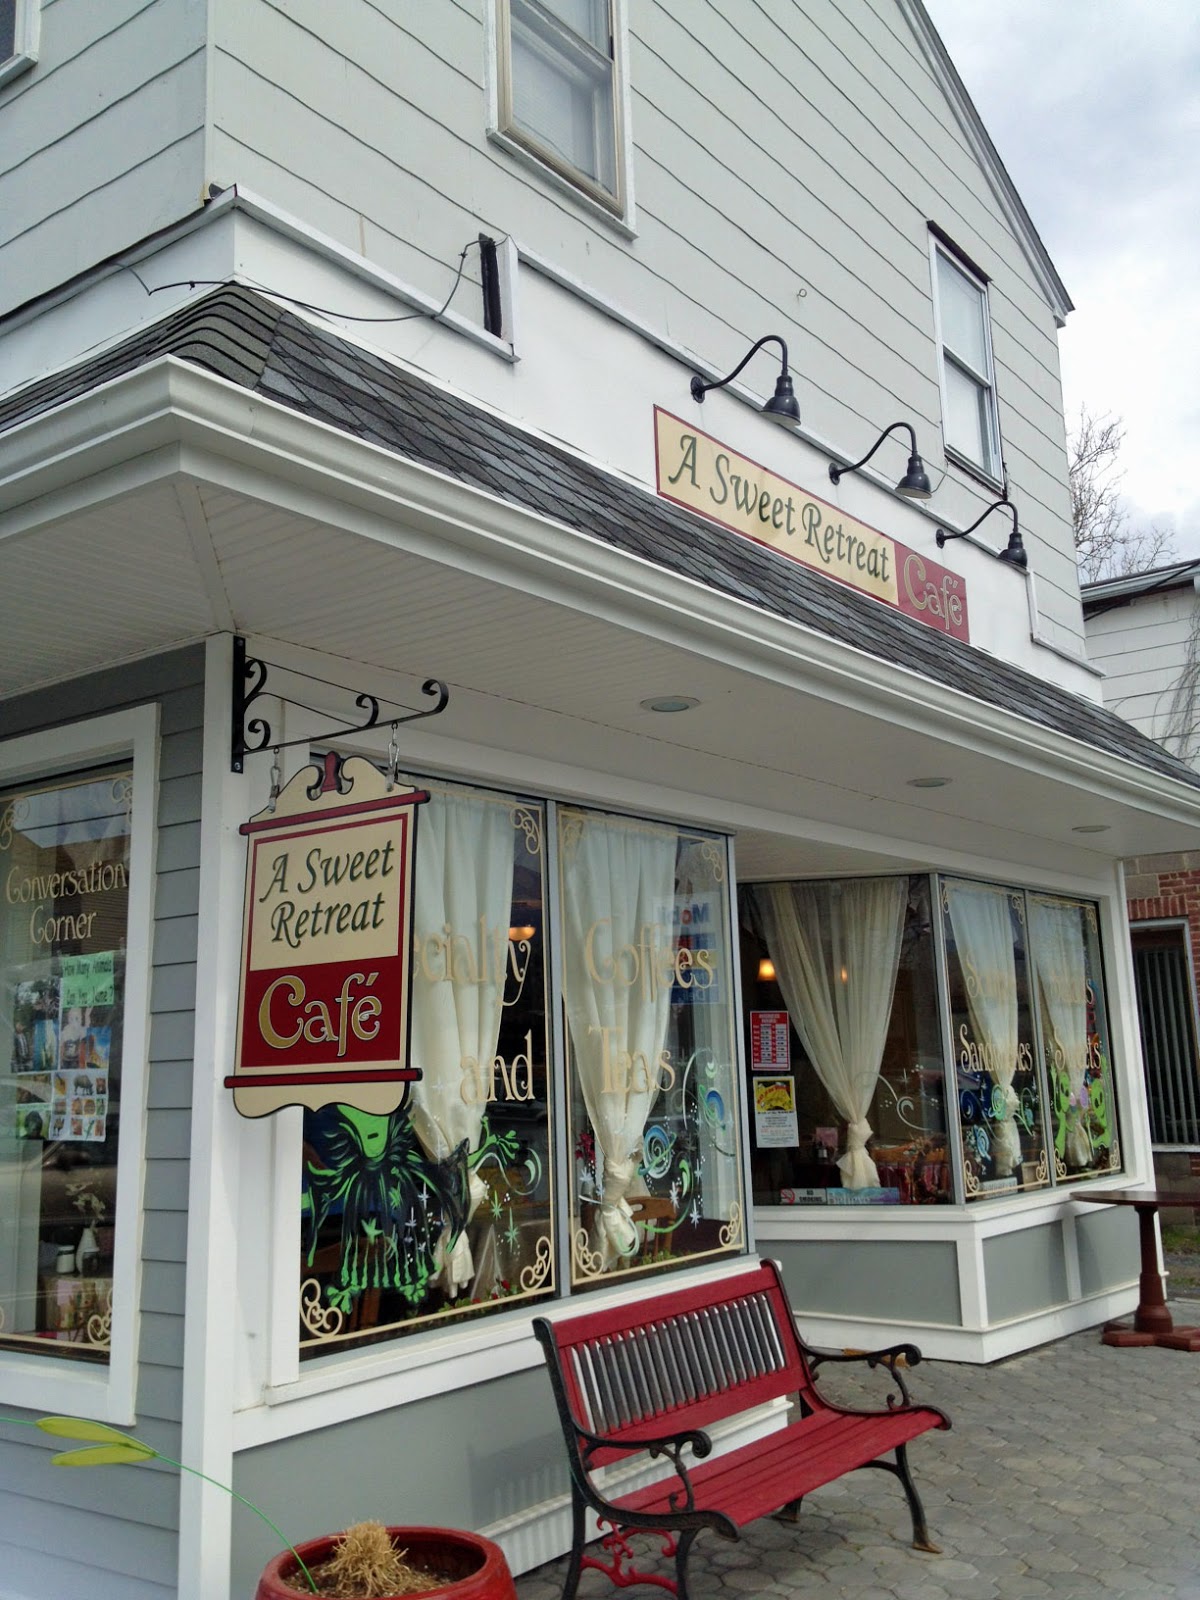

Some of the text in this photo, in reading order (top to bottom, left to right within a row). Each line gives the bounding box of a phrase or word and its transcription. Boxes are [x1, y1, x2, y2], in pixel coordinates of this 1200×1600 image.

[668, 434, 963, 630] A Sweet Retreat Café
[6, 861, 127, 904] Conversation
[259, 840, 394, 903] A Sweet
[30, 905, 97, 944] Corner
[271, 892, 385, 948] Retreat
[585, 918, 714, 1003] Coffees
[258, 971, 382, 1056] Café
[460, 1028, 535, 1105] and
[588, 1025, 675, 1093] Teas
